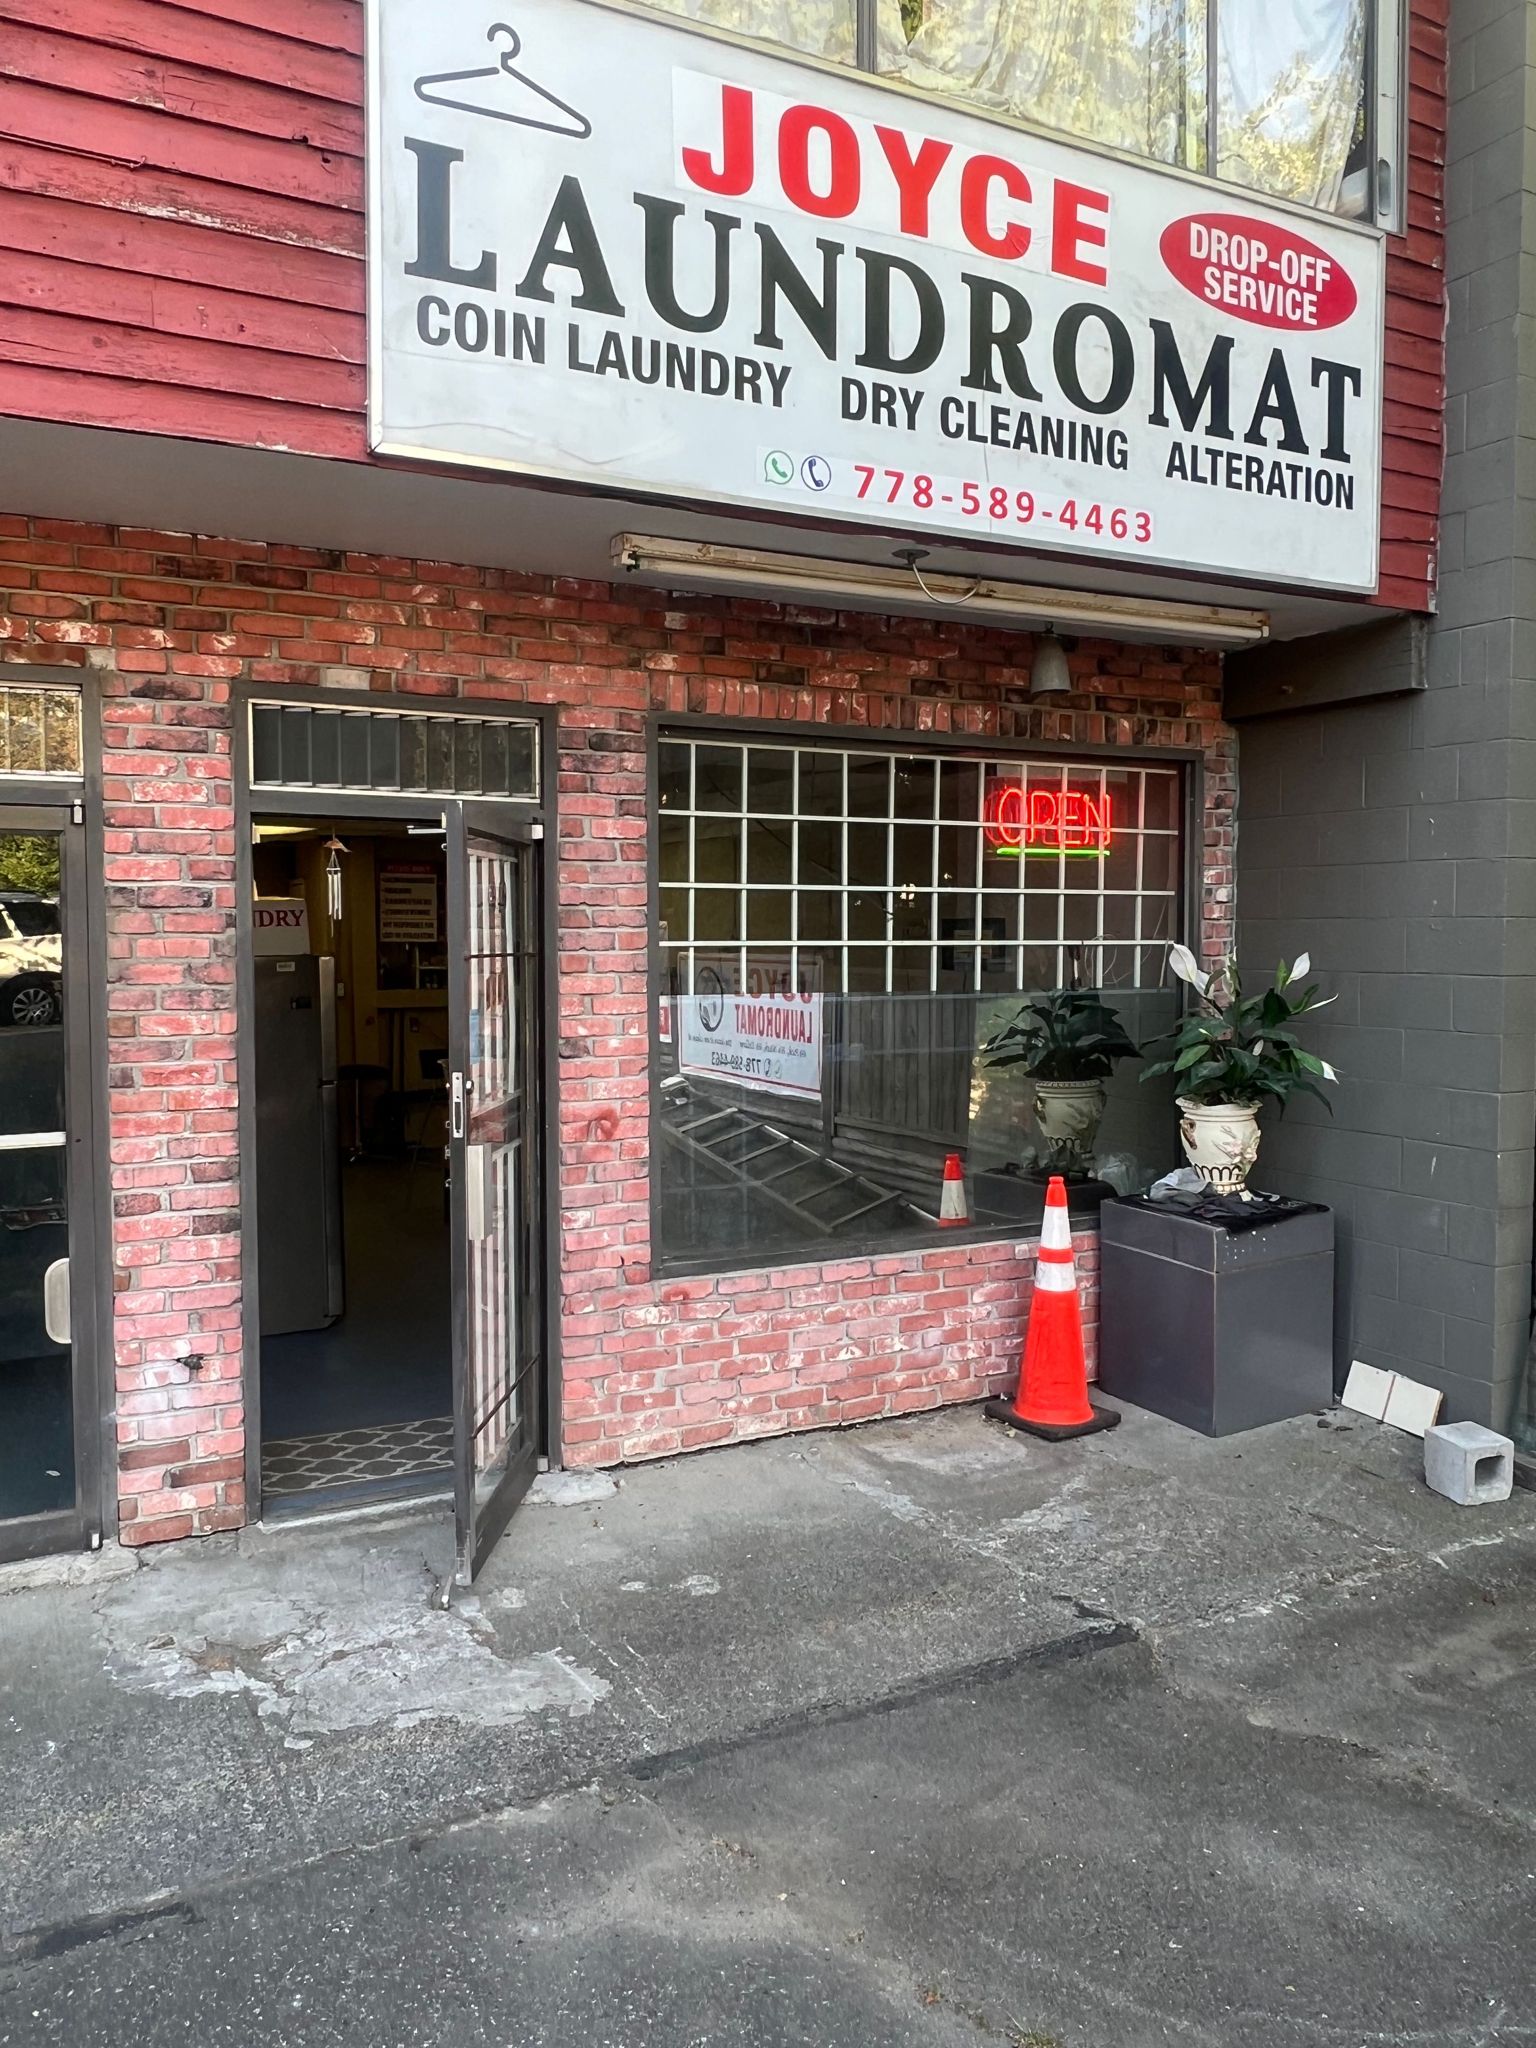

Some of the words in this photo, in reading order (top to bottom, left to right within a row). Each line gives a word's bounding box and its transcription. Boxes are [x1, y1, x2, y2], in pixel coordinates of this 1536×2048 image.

[682, 84, 1109, 287] JOYCE
[1190, 222, 1331, 293] DROP-OFF
[404, 136, 1361, 464] LAUNDROMAT
[1204, 266, 1318, 326] SERVICE
[417, 295, 545, 365] COIN
[568, 323, 792, 408] LAUNDRY
[842, 376, 924, 431] DRY
[940, 396, 1128, 470] CLEANING
[1166, 442, 1354, 510] ALTERATION
[854, 465, 1152, 542] 778-589-4463
[998, 787, 1111, 846] OPEN
[253, 909, 304, 928] DRY
